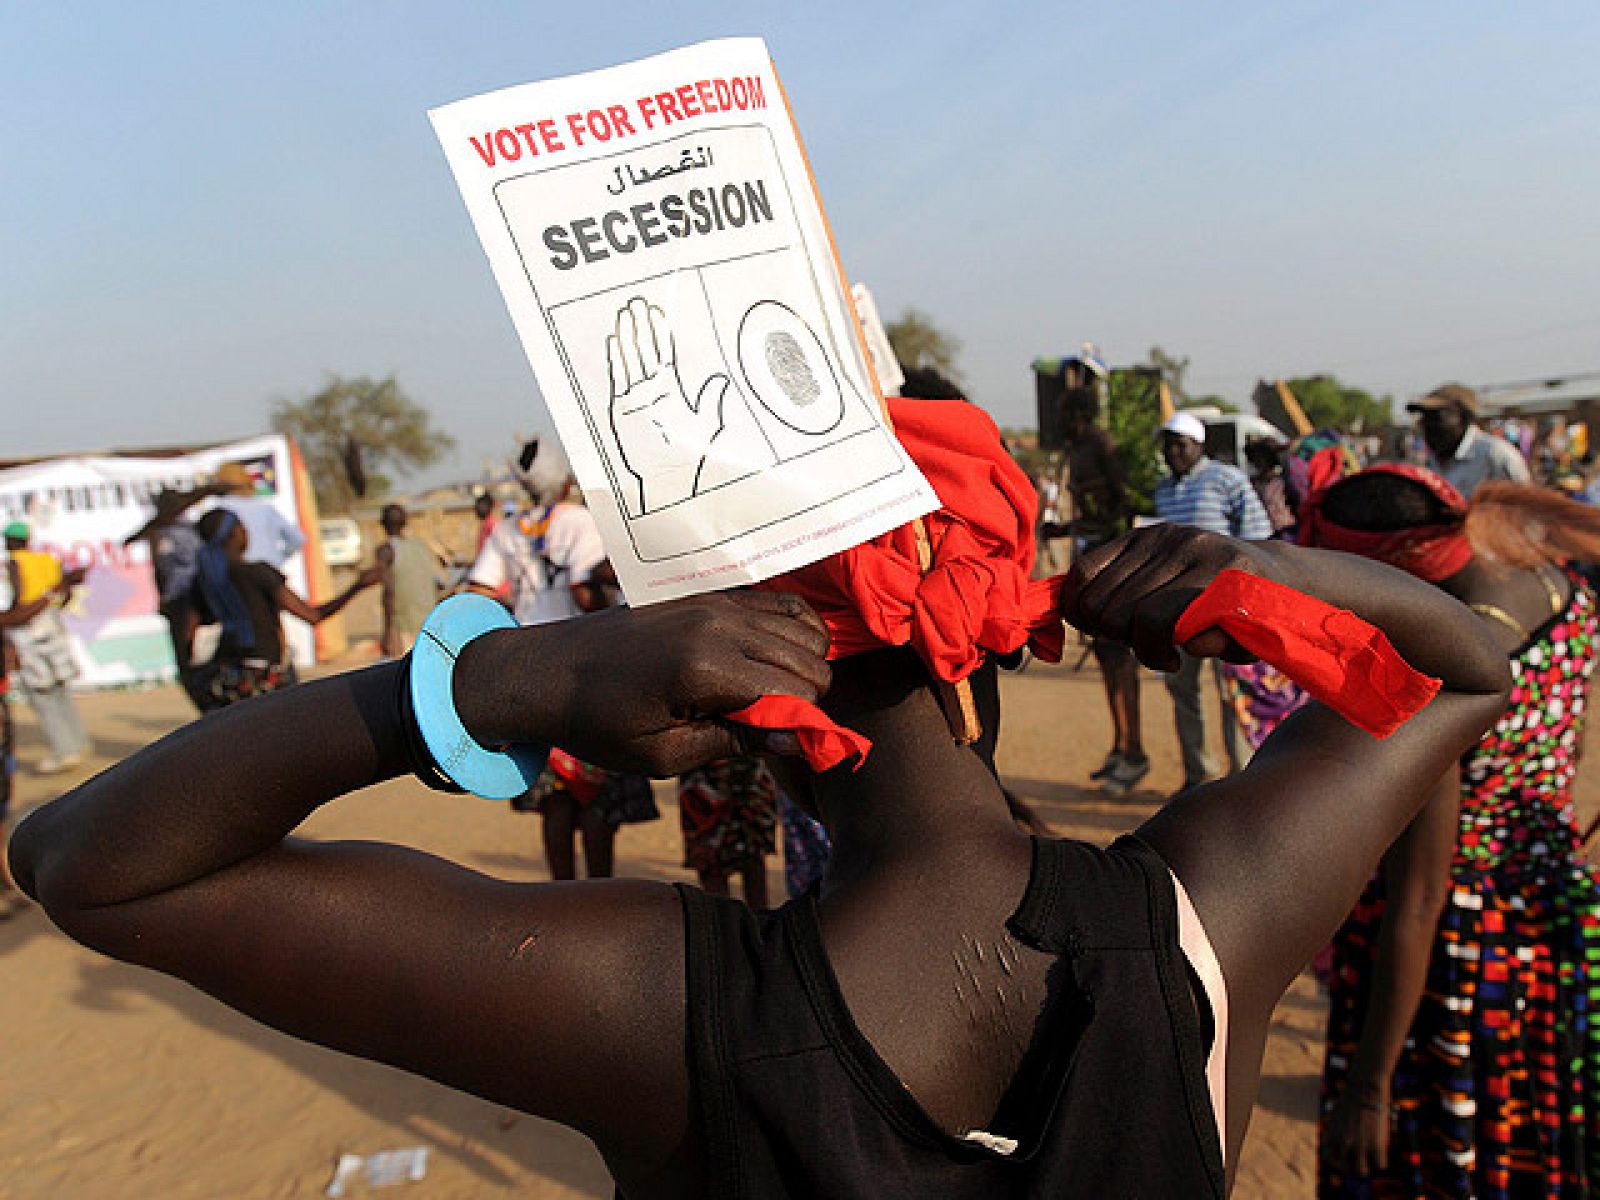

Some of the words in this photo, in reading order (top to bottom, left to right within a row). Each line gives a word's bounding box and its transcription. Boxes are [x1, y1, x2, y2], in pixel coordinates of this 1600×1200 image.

[468, 119, 565, 168] VOTE
[565, 104, 637, 146] FOR
[636, 75, 767, 130] FREEDOM
[542, 179, 774, 271] SECESSION
